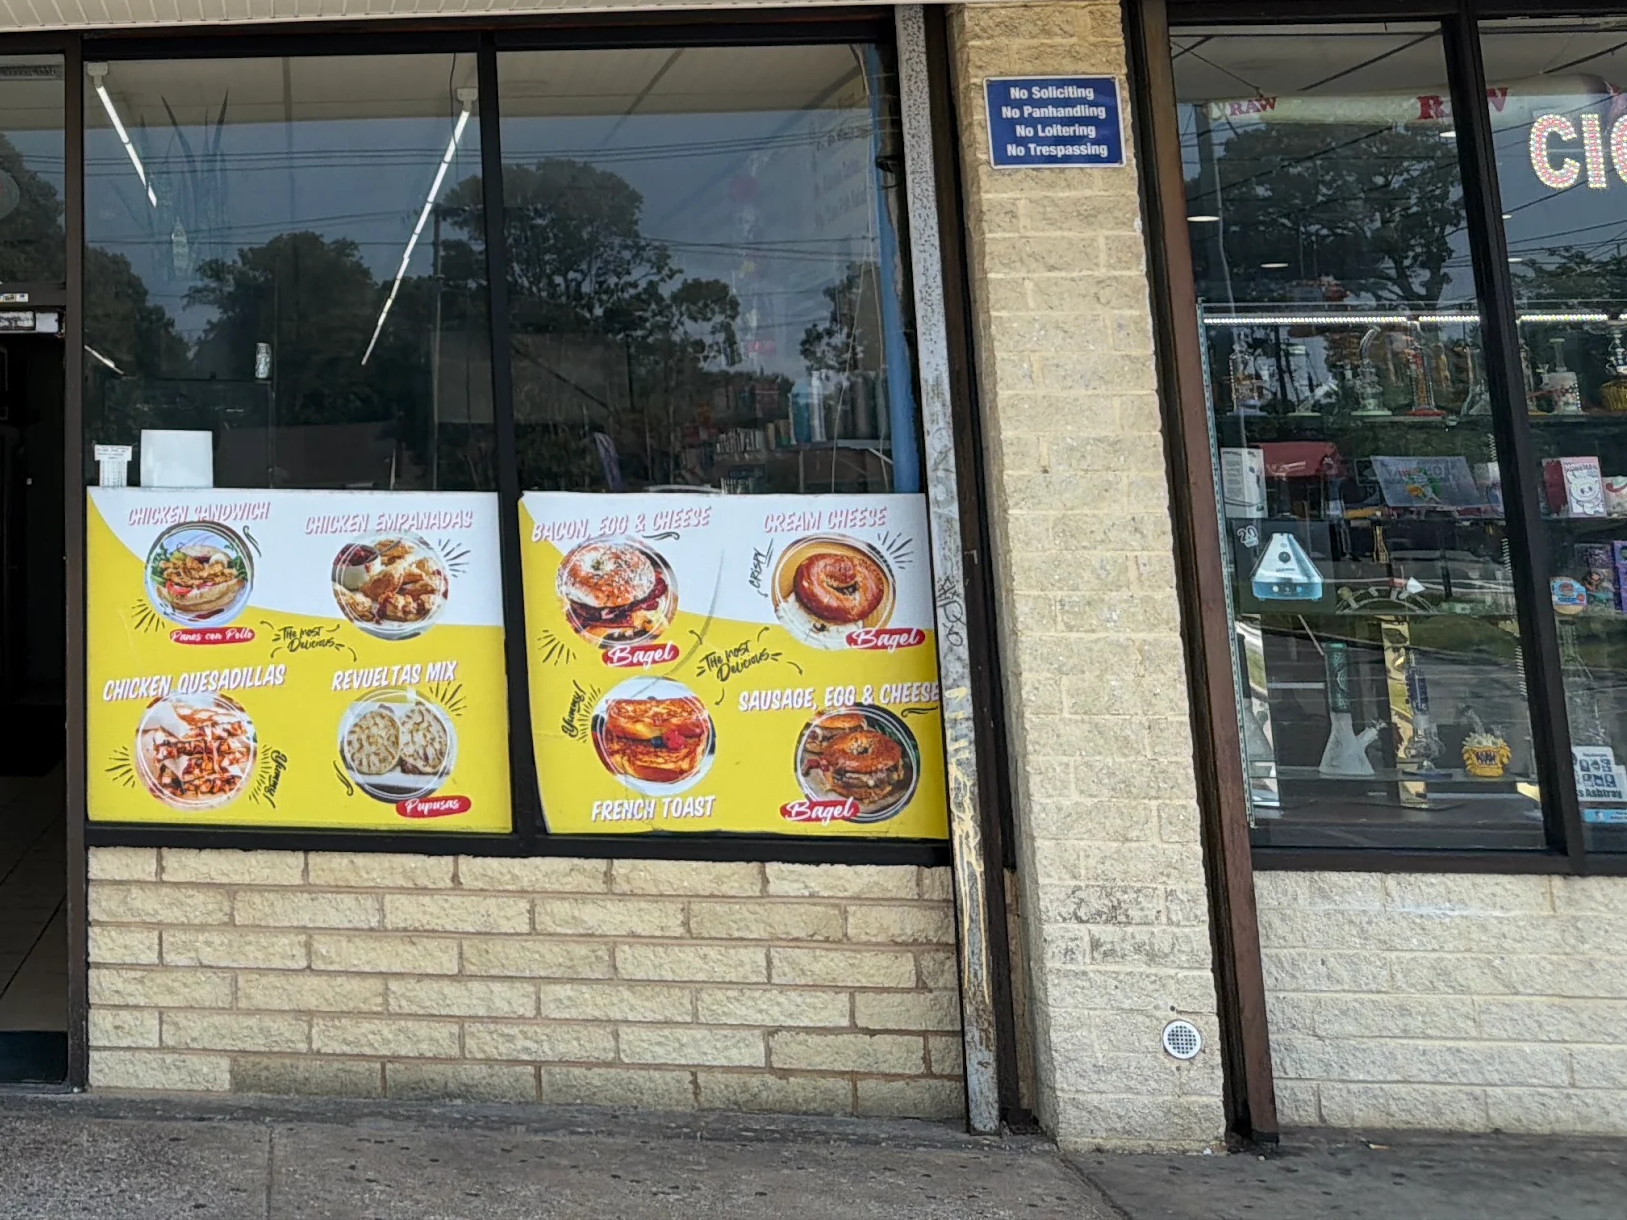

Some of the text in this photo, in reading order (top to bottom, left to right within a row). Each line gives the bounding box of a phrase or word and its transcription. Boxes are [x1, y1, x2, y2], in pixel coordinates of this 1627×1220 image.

[1010, 86, 1094, 100] No Soliciting
[1002, 105, 1106, 119] No Panhandling
[1229, 96, 1276, 116] RAW
[1015, 124, 1096, 138] No Loitering
[1007, 143, 1108, 158] No Trespassing
[129, 501, 270, 526] CHICKEN SANDWICH
[305, 510, 473, 534] CHICKEN EMPANADAS
[532, 506, 712, 543] BACON, EGG & CHEESE
[763, 506, 887, 534] CREAM CHEESE
[171, 628, 253, 641] Panes con Pollo
[850, 628, 919, 651] Bagel
[607, 646, 675, 669] Bagel
[103, 664, 287, 702] CHICKEN QUESADILLAS
[332, 660, 458, 692] REVUELTAS MIX
[738, 681, 941, 712] SAUSAGE, EGG & CHEESE
[404, 797, 460, 815] Pupusas
[591, 795, 716, 822] FRENCH TOAST
[786, 799, 854, 822] Bagel
